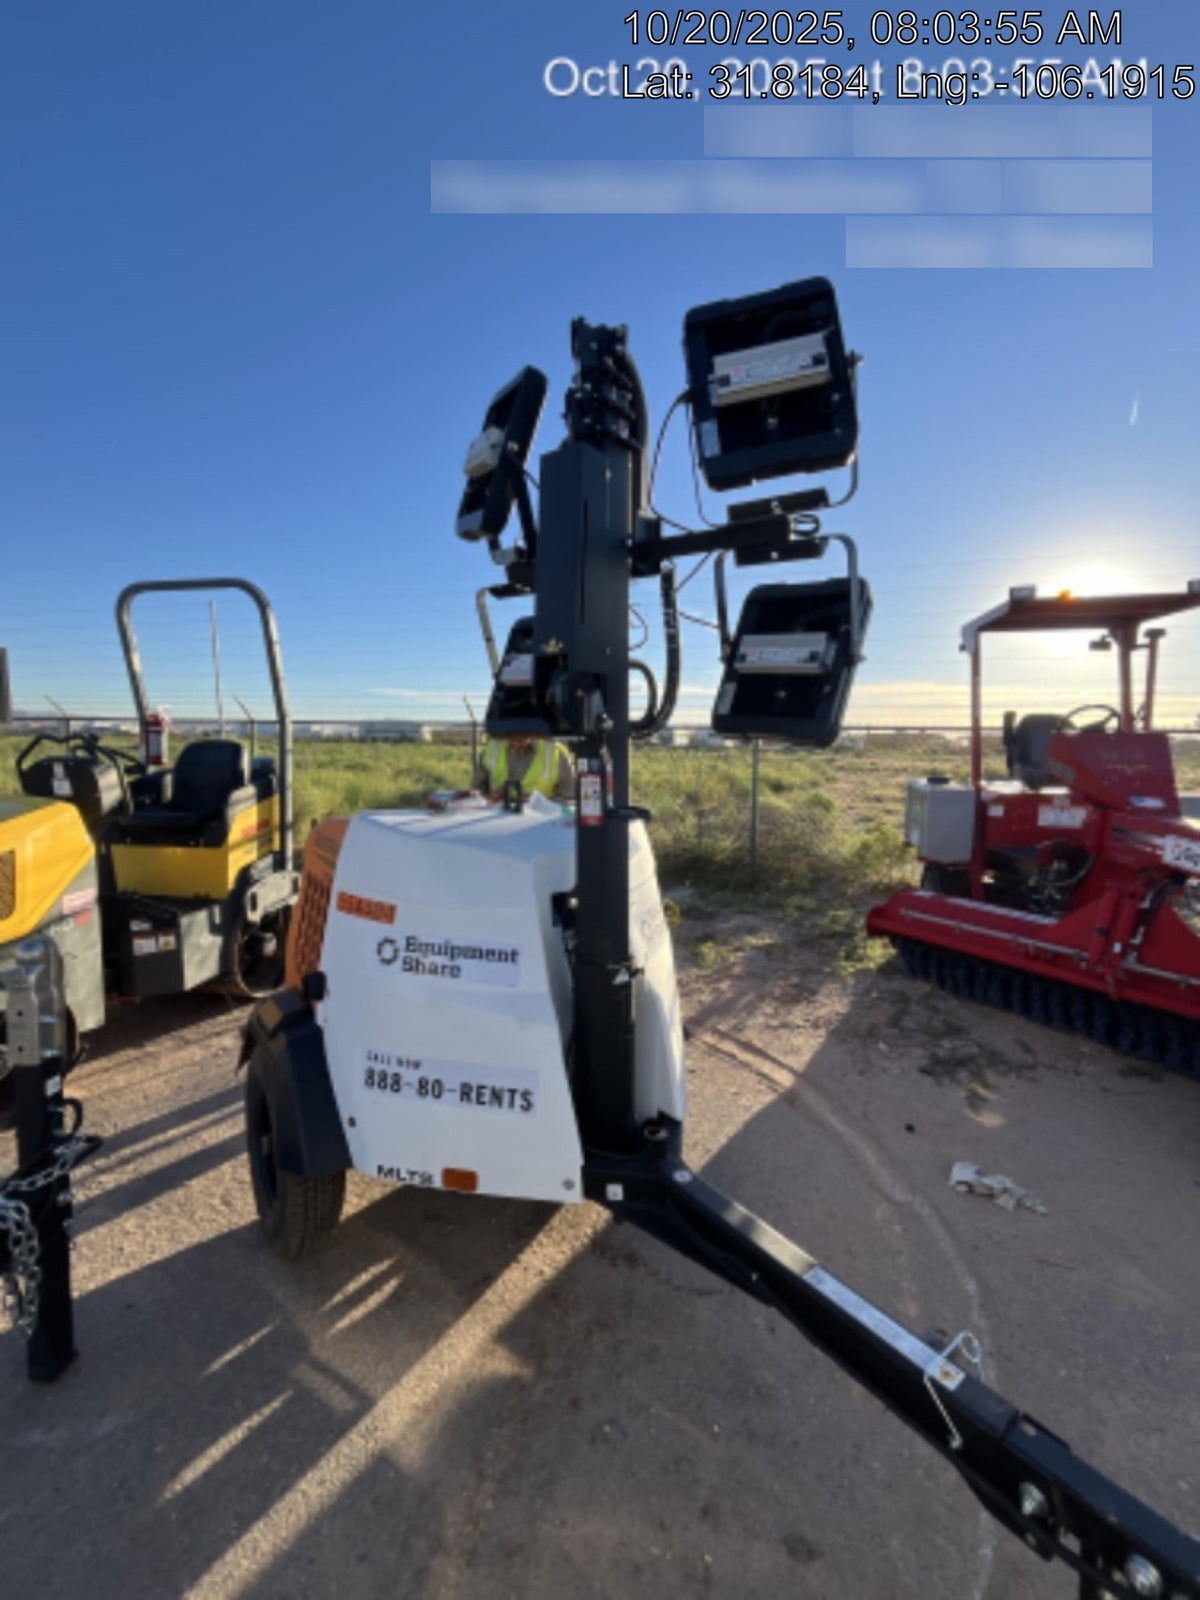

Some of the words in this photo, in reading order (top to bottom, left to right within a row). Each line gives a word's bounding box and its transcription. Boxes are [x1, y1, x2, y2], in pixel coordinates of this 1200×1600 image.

[405, 936, 519, 964] Equipment
[402, 956, 461, 978] Share
[364, 1067, 534, 1112] 888-80-RENTS
